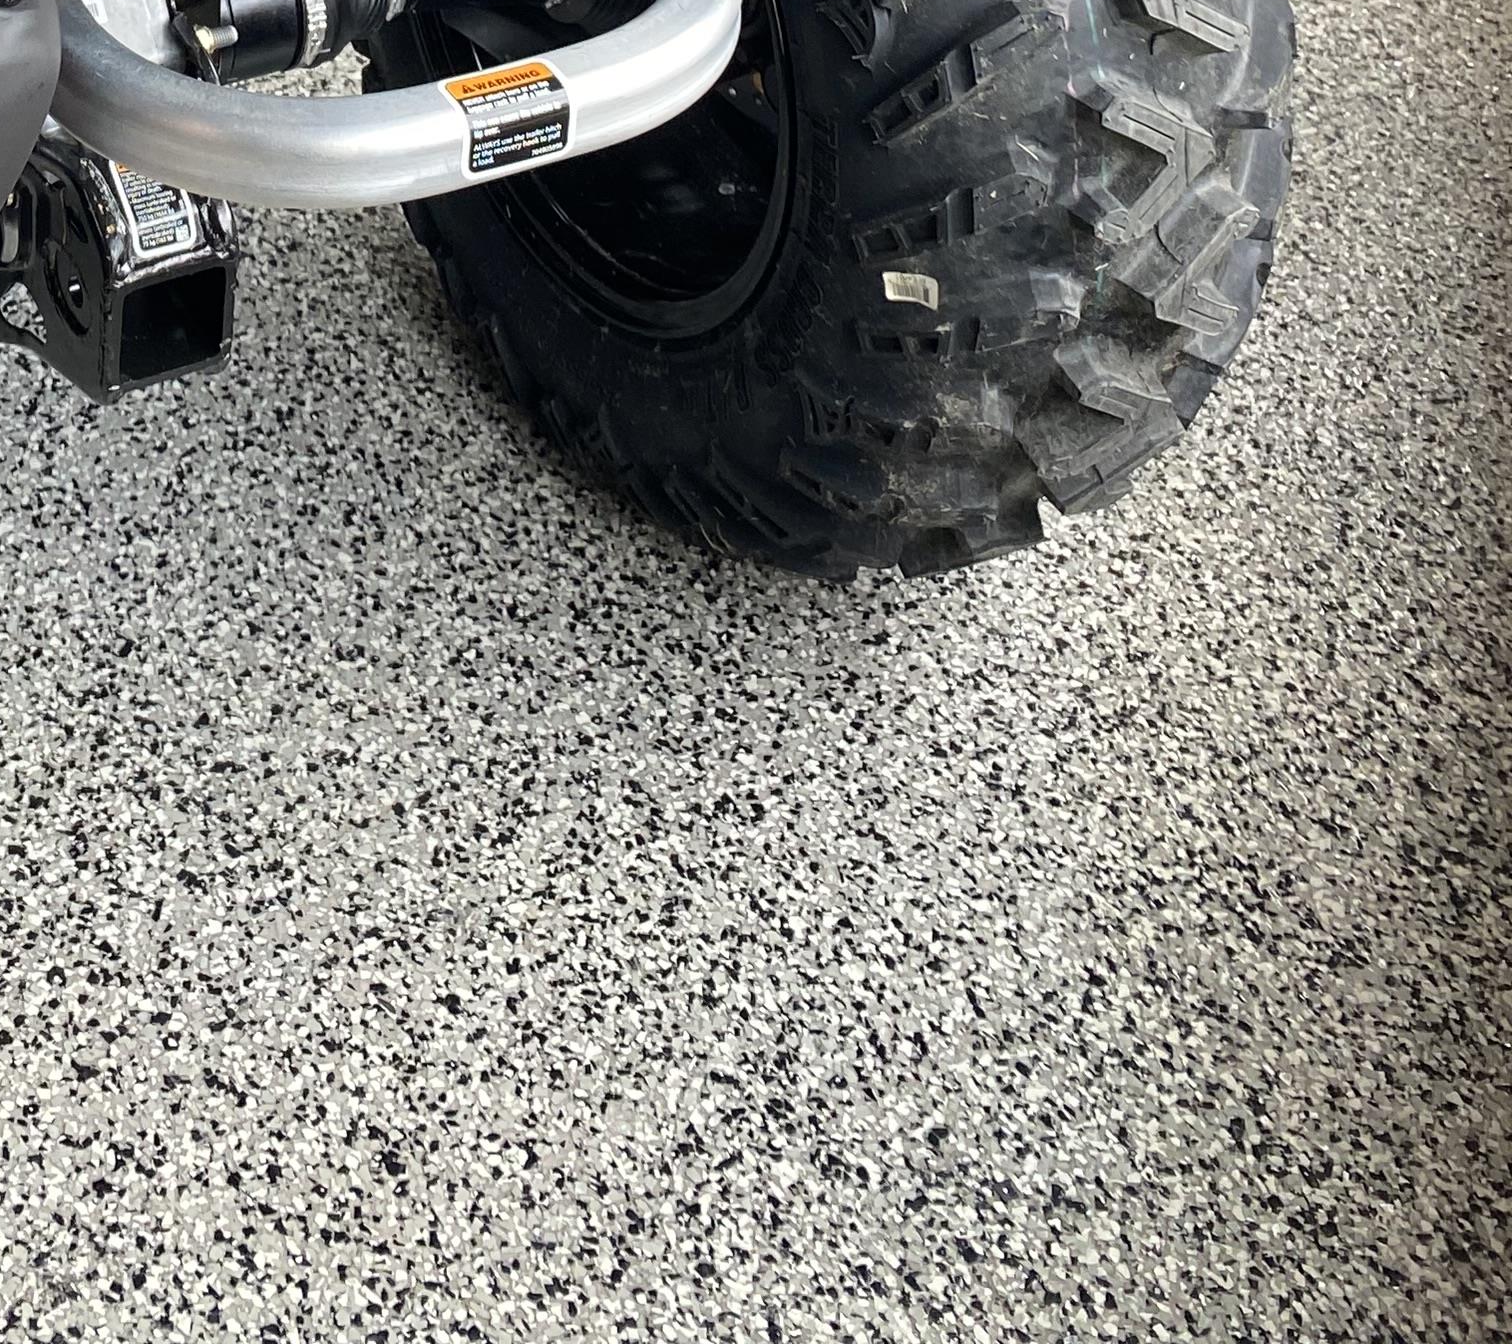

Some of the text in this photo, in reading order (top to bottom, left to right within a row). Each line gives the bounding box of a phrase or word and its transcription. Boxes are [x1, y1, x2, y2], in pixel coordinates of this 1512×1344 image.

[473, 70, 540, 90] WARNING
[473, 138, 501, 152] ALWAYS
[513, 132, 525, 142] the
[525, 129, 545, 140] trailer
[545, 123, 562, 135] hitch
[481, 147, 494, 157] the
[494, 141, 522, 154] recovery
[522, 136, 539, 149] hook
[547, 131, 561, 142] pull
